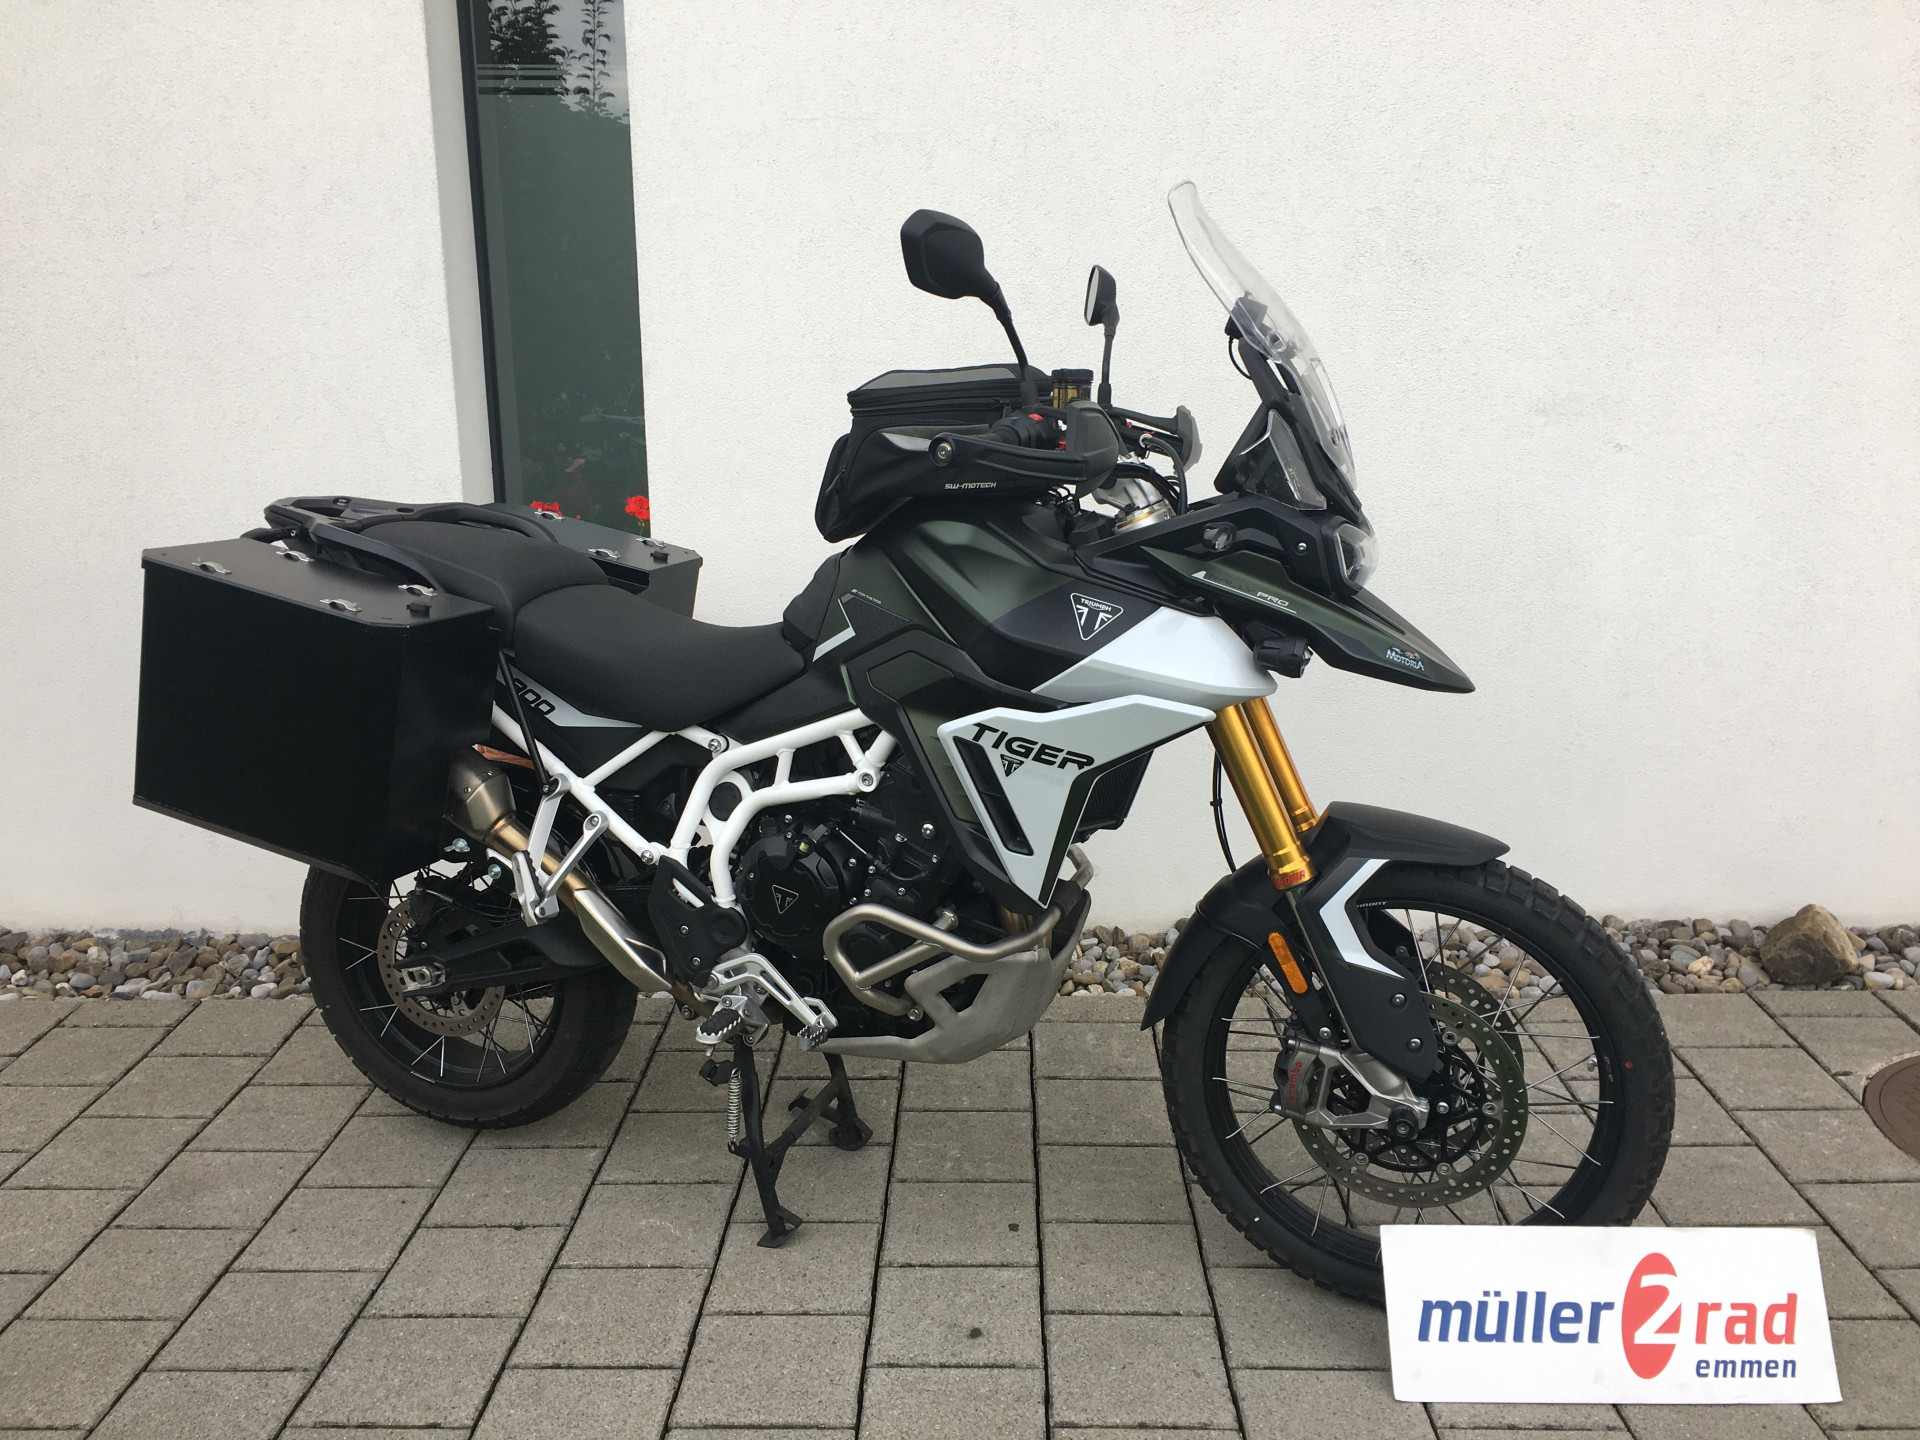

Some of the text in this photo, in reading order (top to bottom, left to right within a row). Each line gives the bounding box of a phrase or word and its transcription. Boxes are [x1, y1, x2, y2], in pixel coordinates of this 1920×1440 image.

[944, 481, 997, 490] SW-MOTECH
[1080, 597, 1112, 612] TRIUMPH
[1256, 591, 1289, 607] PRO
[972, 722, 1095, 770] TIGER
[1273, 869, 1306, 887] SHOWA
[1286, 1061, 1303, 1102] brembo
[1417, 1272, 1798, 1345] müller 2 rad
[1695, 1357, 1797, 1379] emmen
